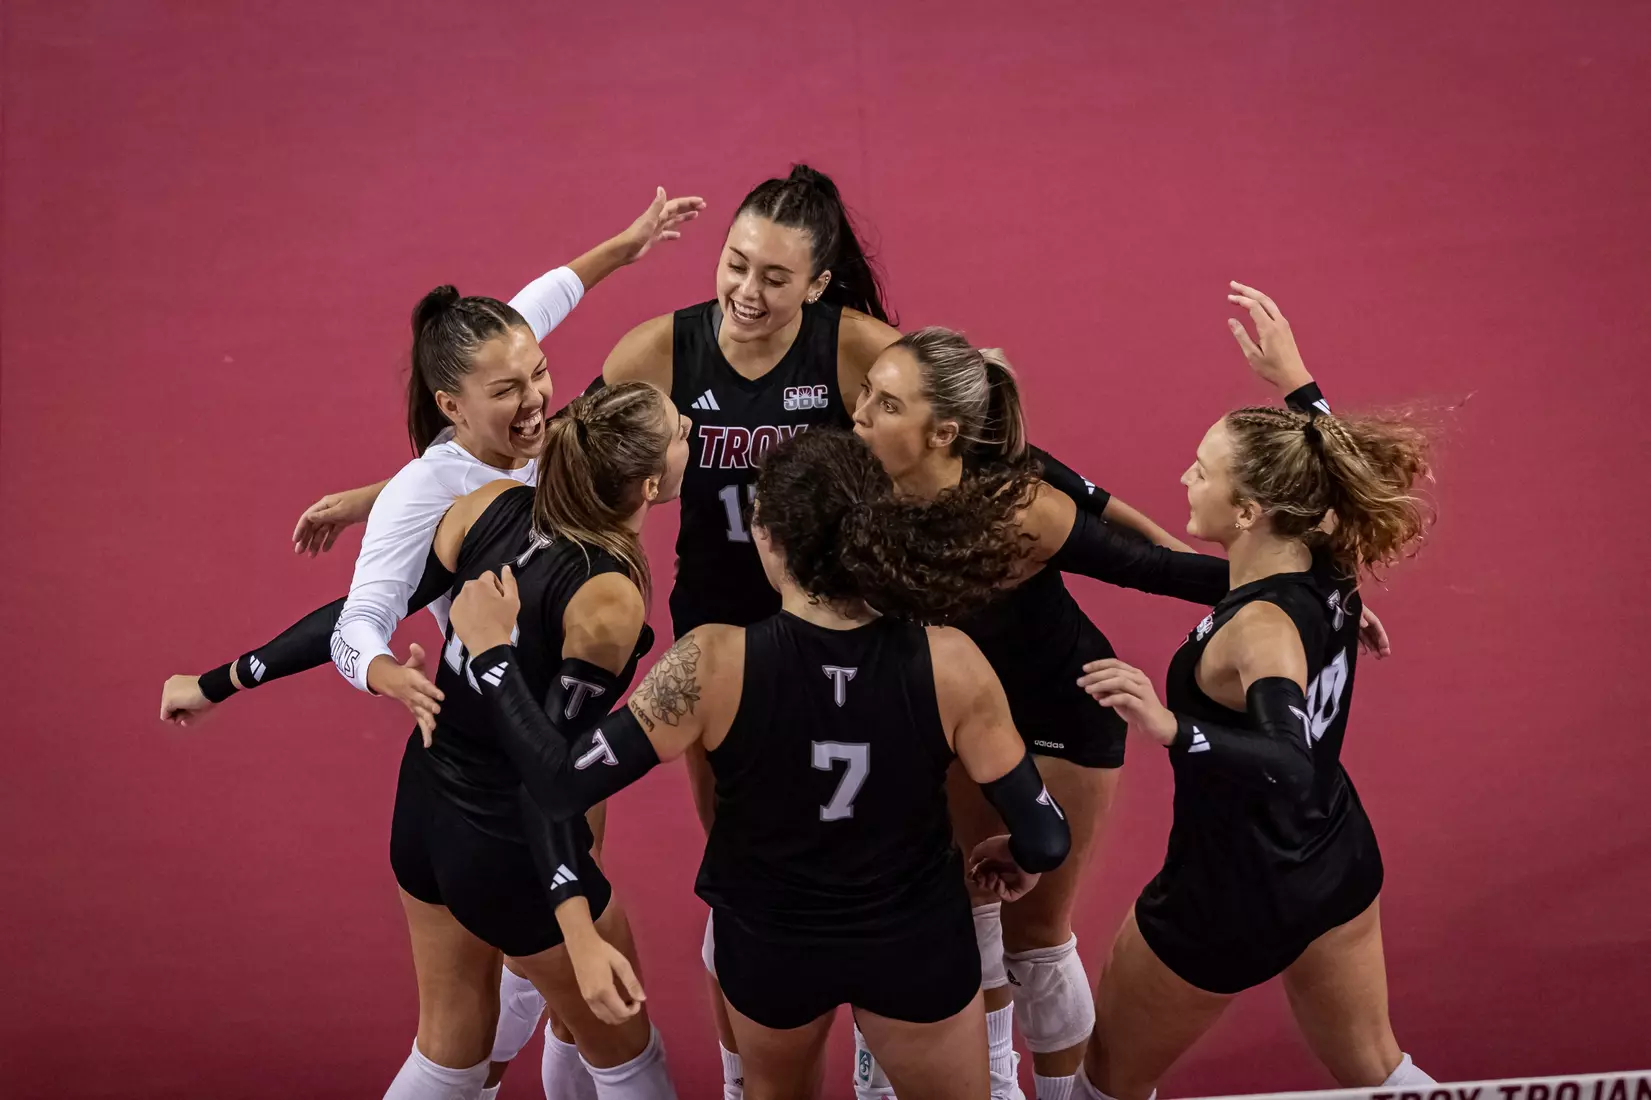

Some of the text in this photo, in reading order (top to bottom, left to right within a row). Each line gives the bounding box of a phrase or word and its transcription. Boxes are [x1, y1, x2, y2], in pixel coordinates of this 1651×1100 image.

[783, 385, 828, 411] SBC
[822, 665, 858, 707] T
[1034, 740, 1064, 749] adidas
[811, 740, 870, 821] 7
